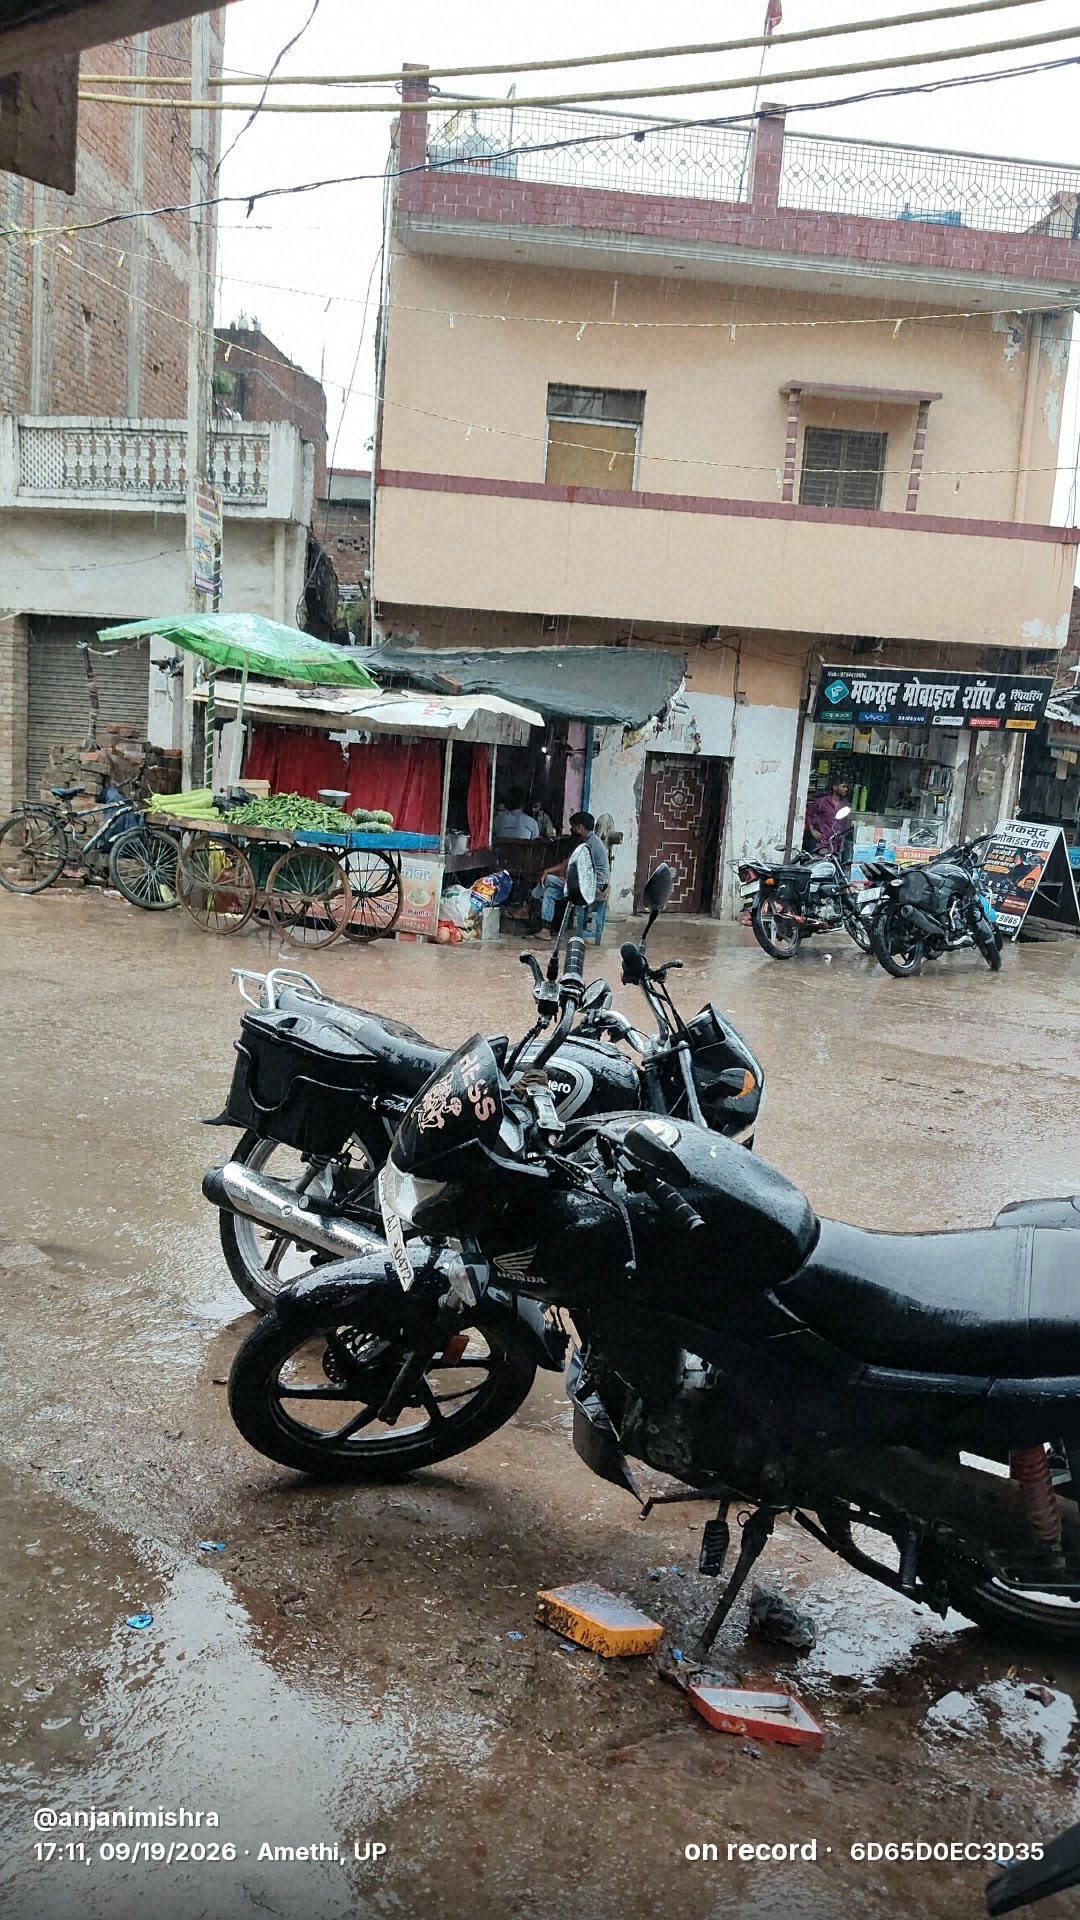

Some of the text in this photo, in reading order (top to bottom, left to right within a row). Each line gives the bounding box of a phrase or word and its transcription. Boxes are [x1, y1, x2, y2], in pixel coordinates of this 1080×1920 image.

[850, 676, 1006, 712] मकसूद मोबाइल शॉप &
[1005, 823, 1049, 839] मकसूद
[548, 1080, 572, 1094] ero
[394, 1247, 412, 1284] 0472
[496, 1270, 548, 1285] HONDA
